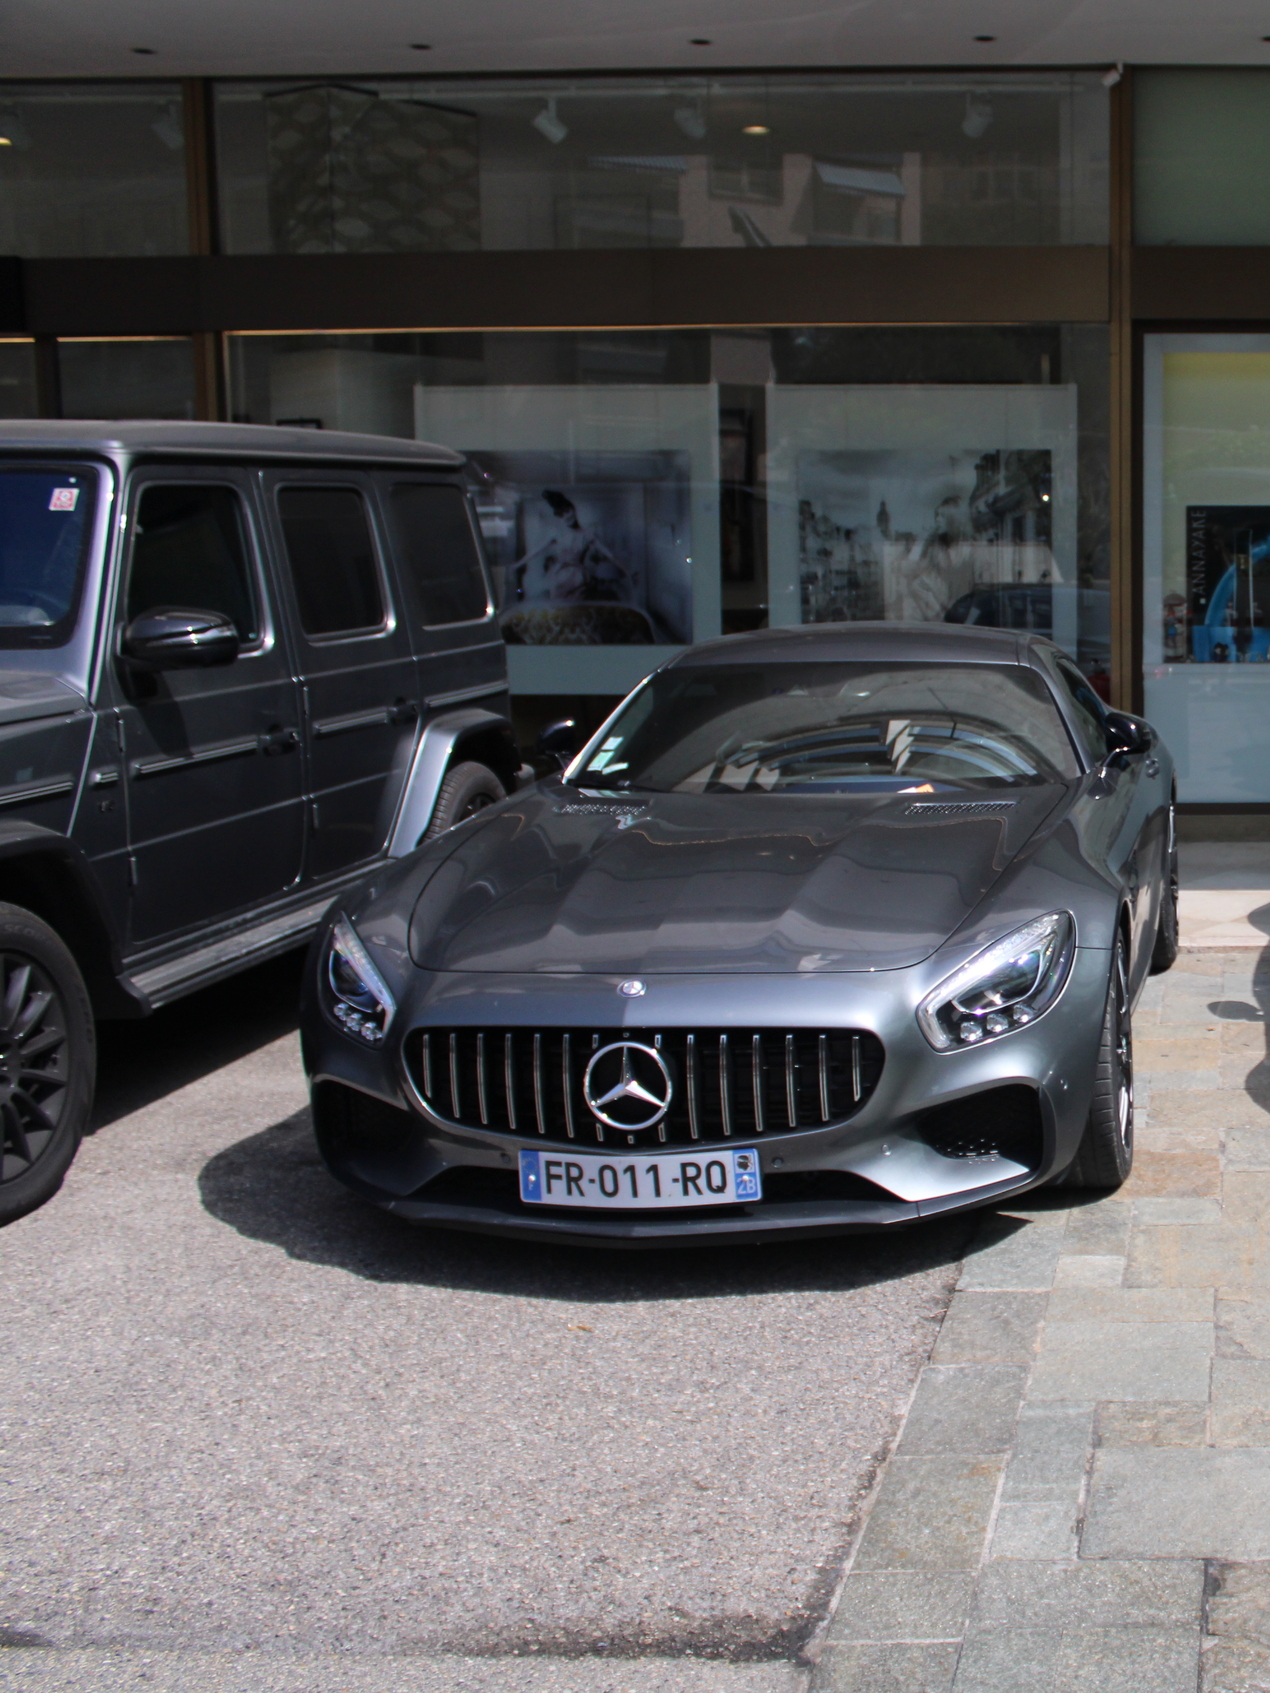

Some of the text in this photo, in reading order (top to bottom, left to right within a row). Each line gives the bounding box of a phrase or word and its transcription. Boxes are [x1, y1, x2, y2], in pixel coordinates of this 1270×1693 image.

[1191, 511, 1206, 594] ANNAYAKE
[544, 1160, 727, 1198] FR-011-RQ
[737, 1178, 756, 1194] 2B
